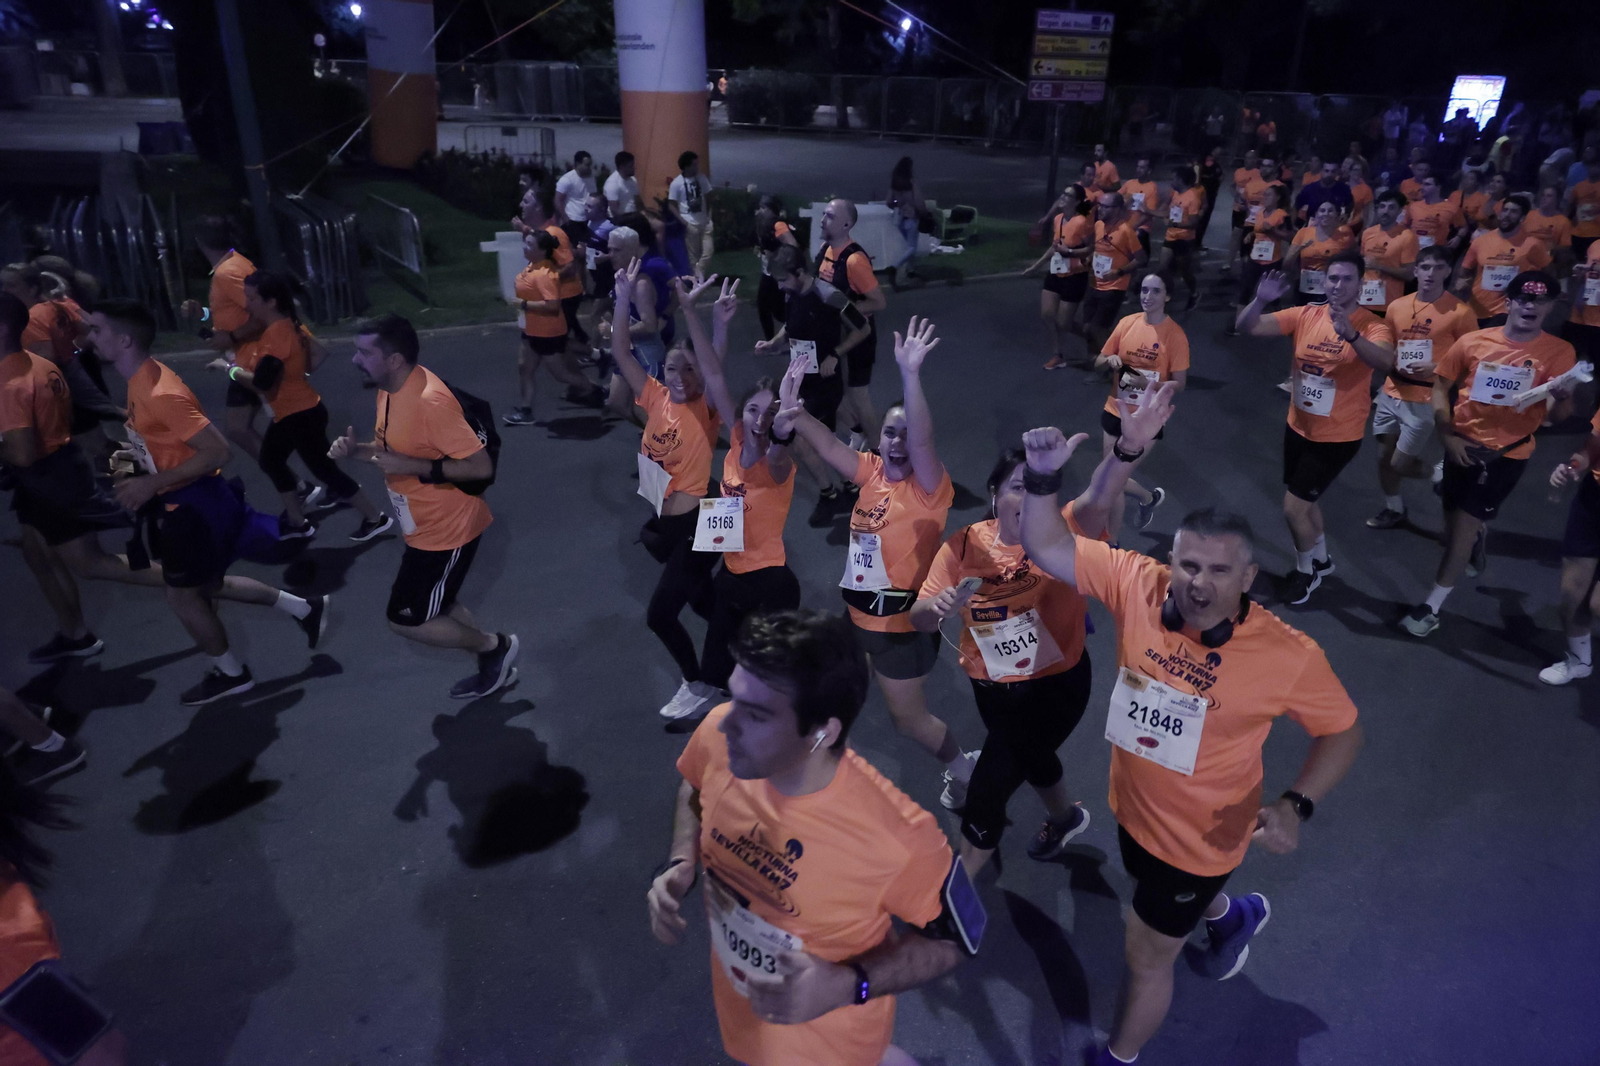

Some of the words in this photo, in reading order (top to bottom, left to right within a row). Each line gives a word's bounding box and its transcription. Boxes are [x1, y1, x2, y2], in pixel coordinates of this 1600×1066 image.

[1401, 351, 1424, 360] 20549
[1486, 377, 1521, 391] 20502
[707, 516, 734, 529] 15168
[853, 553, 873, 568] 14702
[994, 632, 1038, 657] 15314
[1145, 648, 1184, 679] SEVILLA
[1168, 653, 1218, 684] NOCTURNA
[1127, 701, 1183, 737] 21848
[710, 827, 760, 871] SEVILLA
[738, 835, 799, 882] NOCTURNA
[722, 923, 776, 974] 19993
